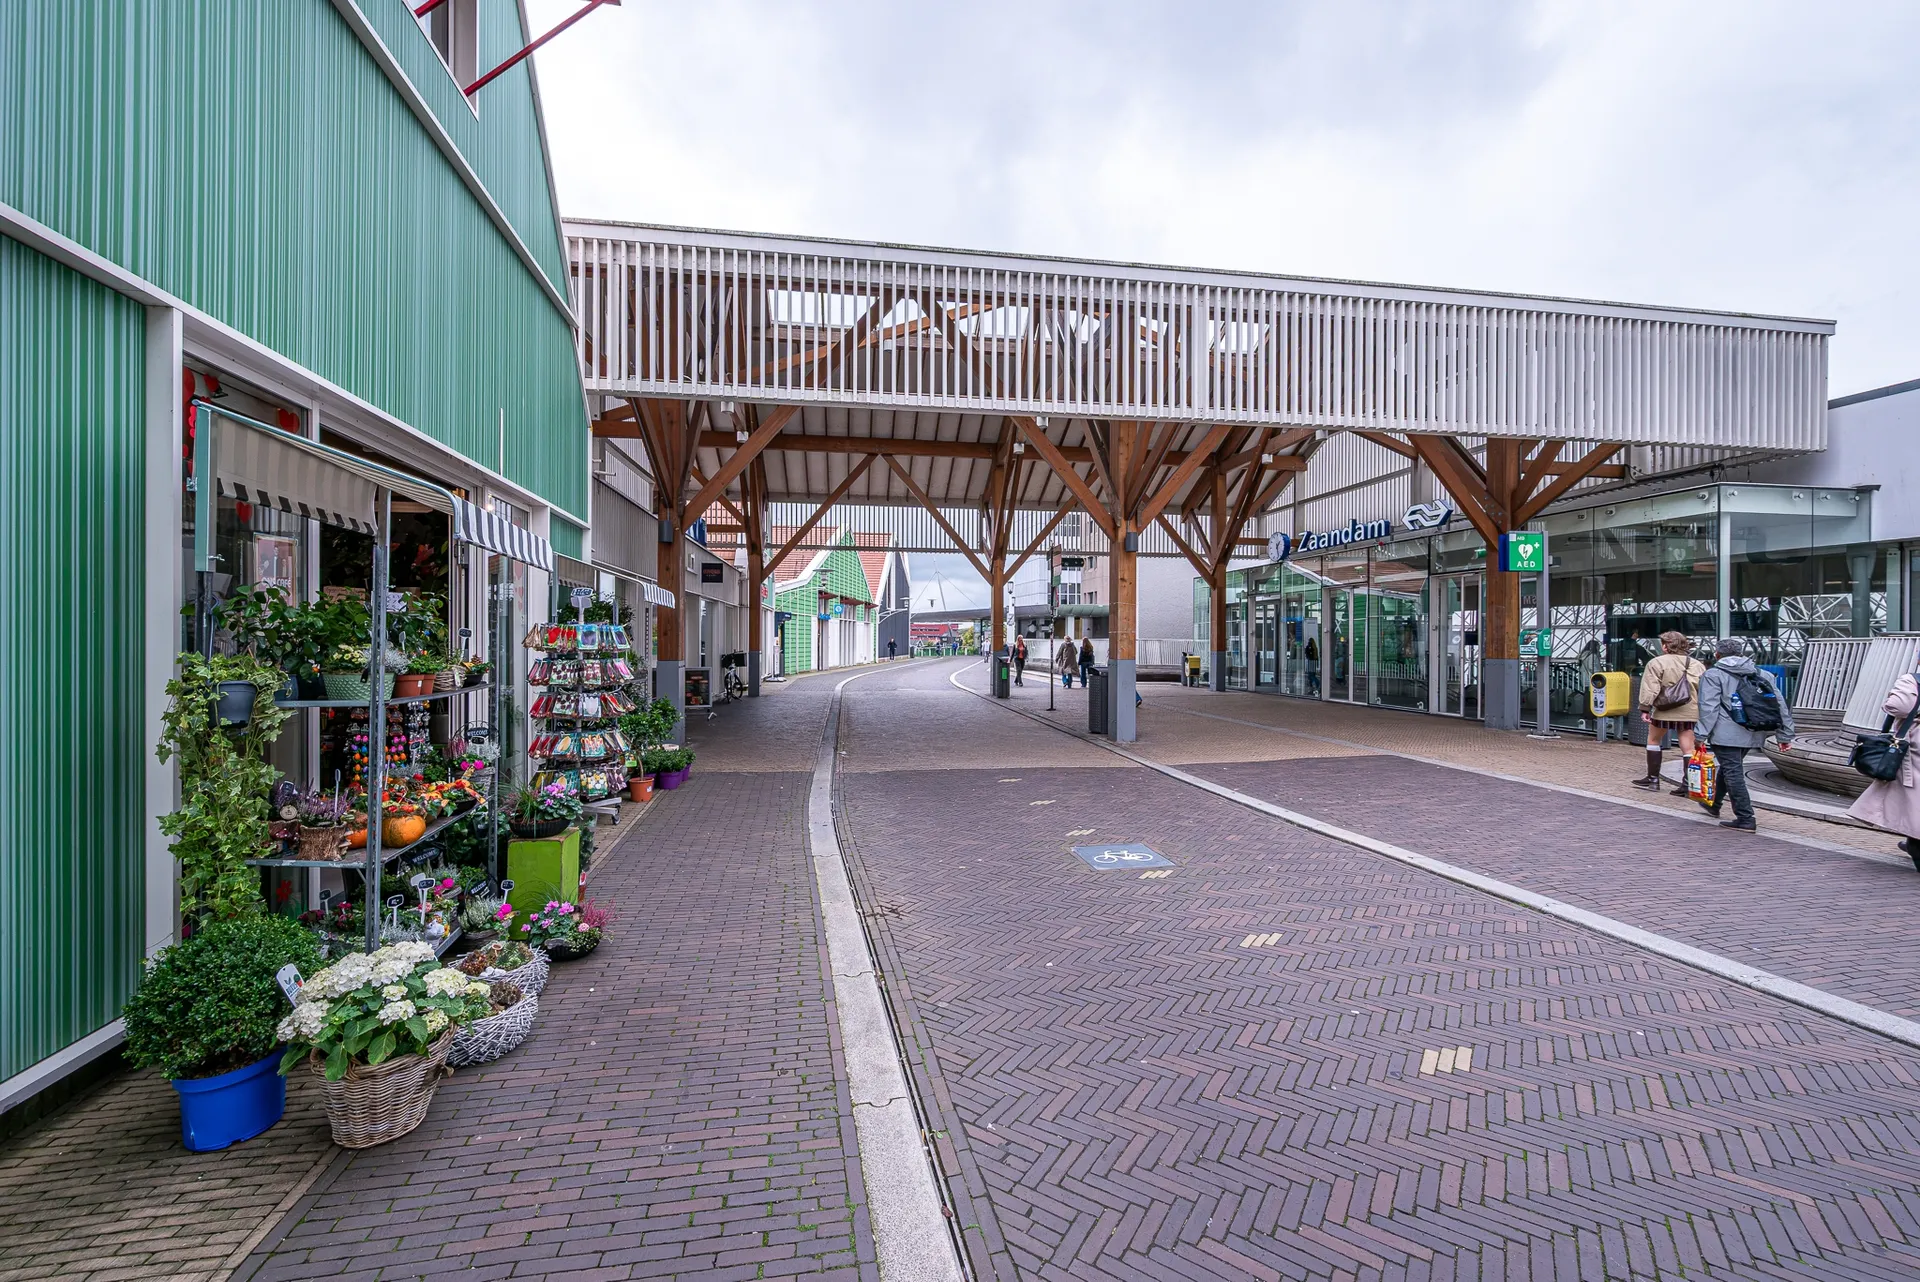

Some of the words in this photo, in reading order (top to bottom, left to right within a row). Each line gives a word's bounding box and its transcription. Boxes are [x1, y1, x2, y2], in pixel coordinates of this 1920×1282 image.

[1297, 519, 1388, 552] Zaandam
[1516, 560, 1536, 568] AED
[412, 850, 437, 863] WELCOME
